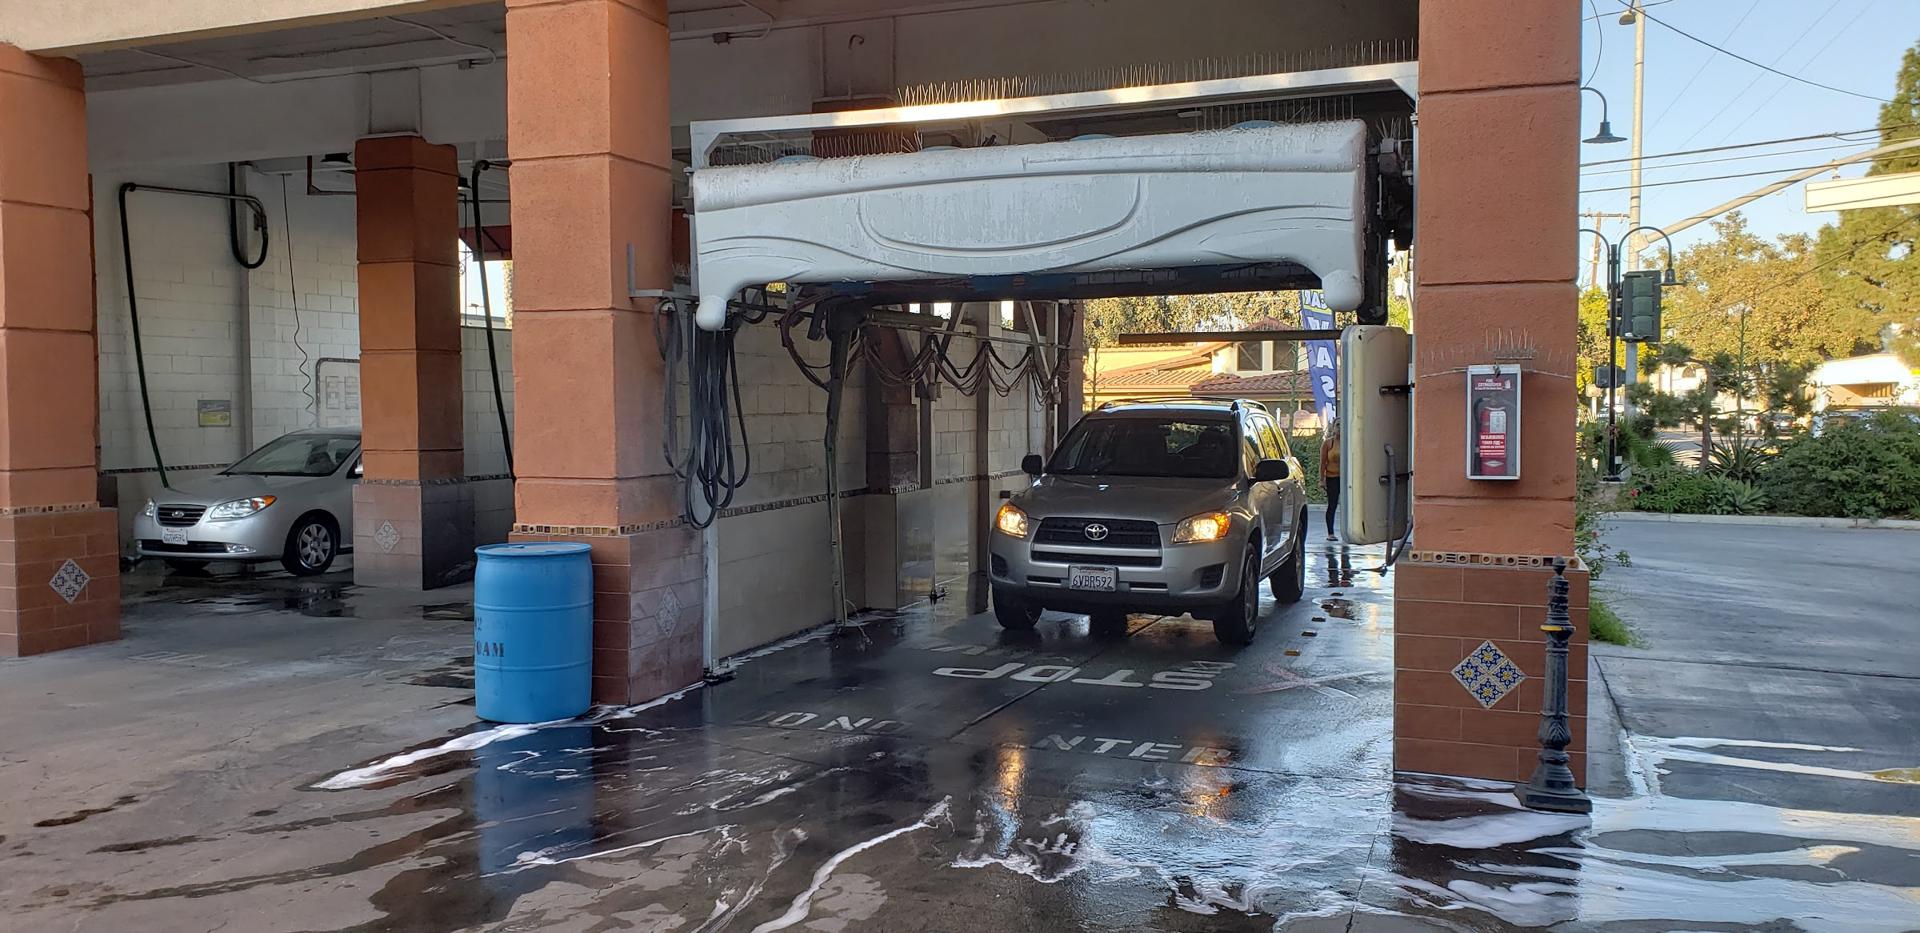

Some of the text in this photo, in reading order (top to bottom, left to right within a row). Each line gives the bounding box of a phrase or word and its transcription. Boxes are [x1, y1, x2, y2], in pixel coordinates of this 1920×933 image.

[1072, 574, 1113, 589] 6VBR592
[475, 640, 505, 657] OAM
[932, 662, 1213, 690] STOP
[1031, 733, 1233, 766] NTER
